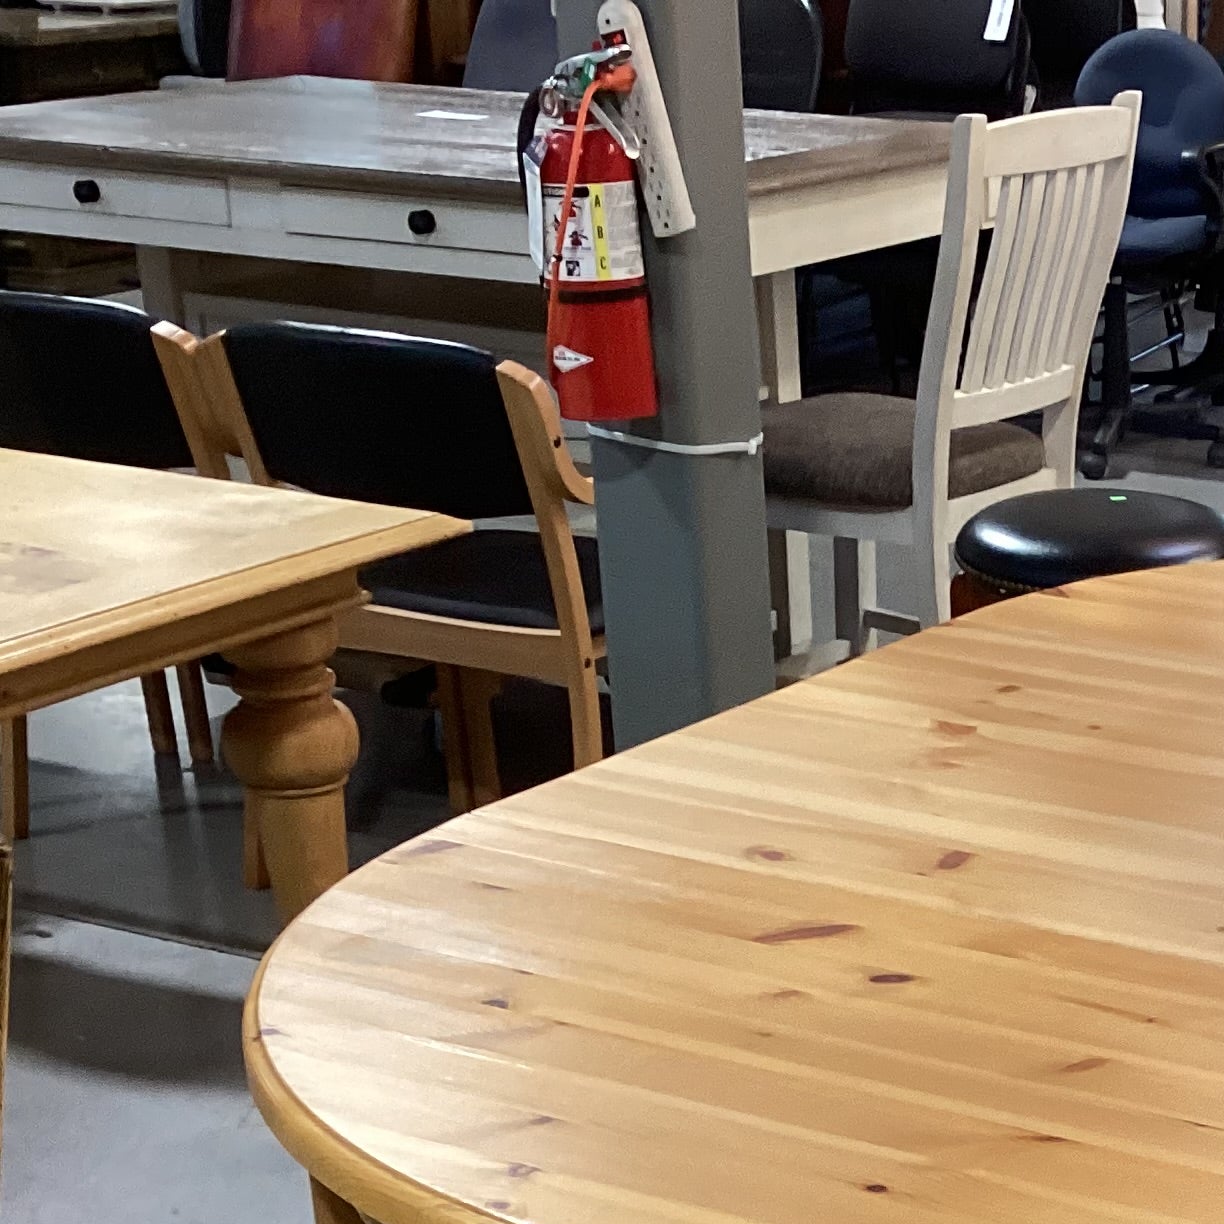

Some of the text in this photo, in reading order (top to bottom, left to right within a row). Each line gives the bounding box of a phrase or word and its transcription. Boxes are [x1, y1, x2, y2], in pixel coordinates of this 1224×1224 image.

[594, 194, 601, 208] A
[597, 226, 603, 239] B
[600, 257, 607, 270] C
